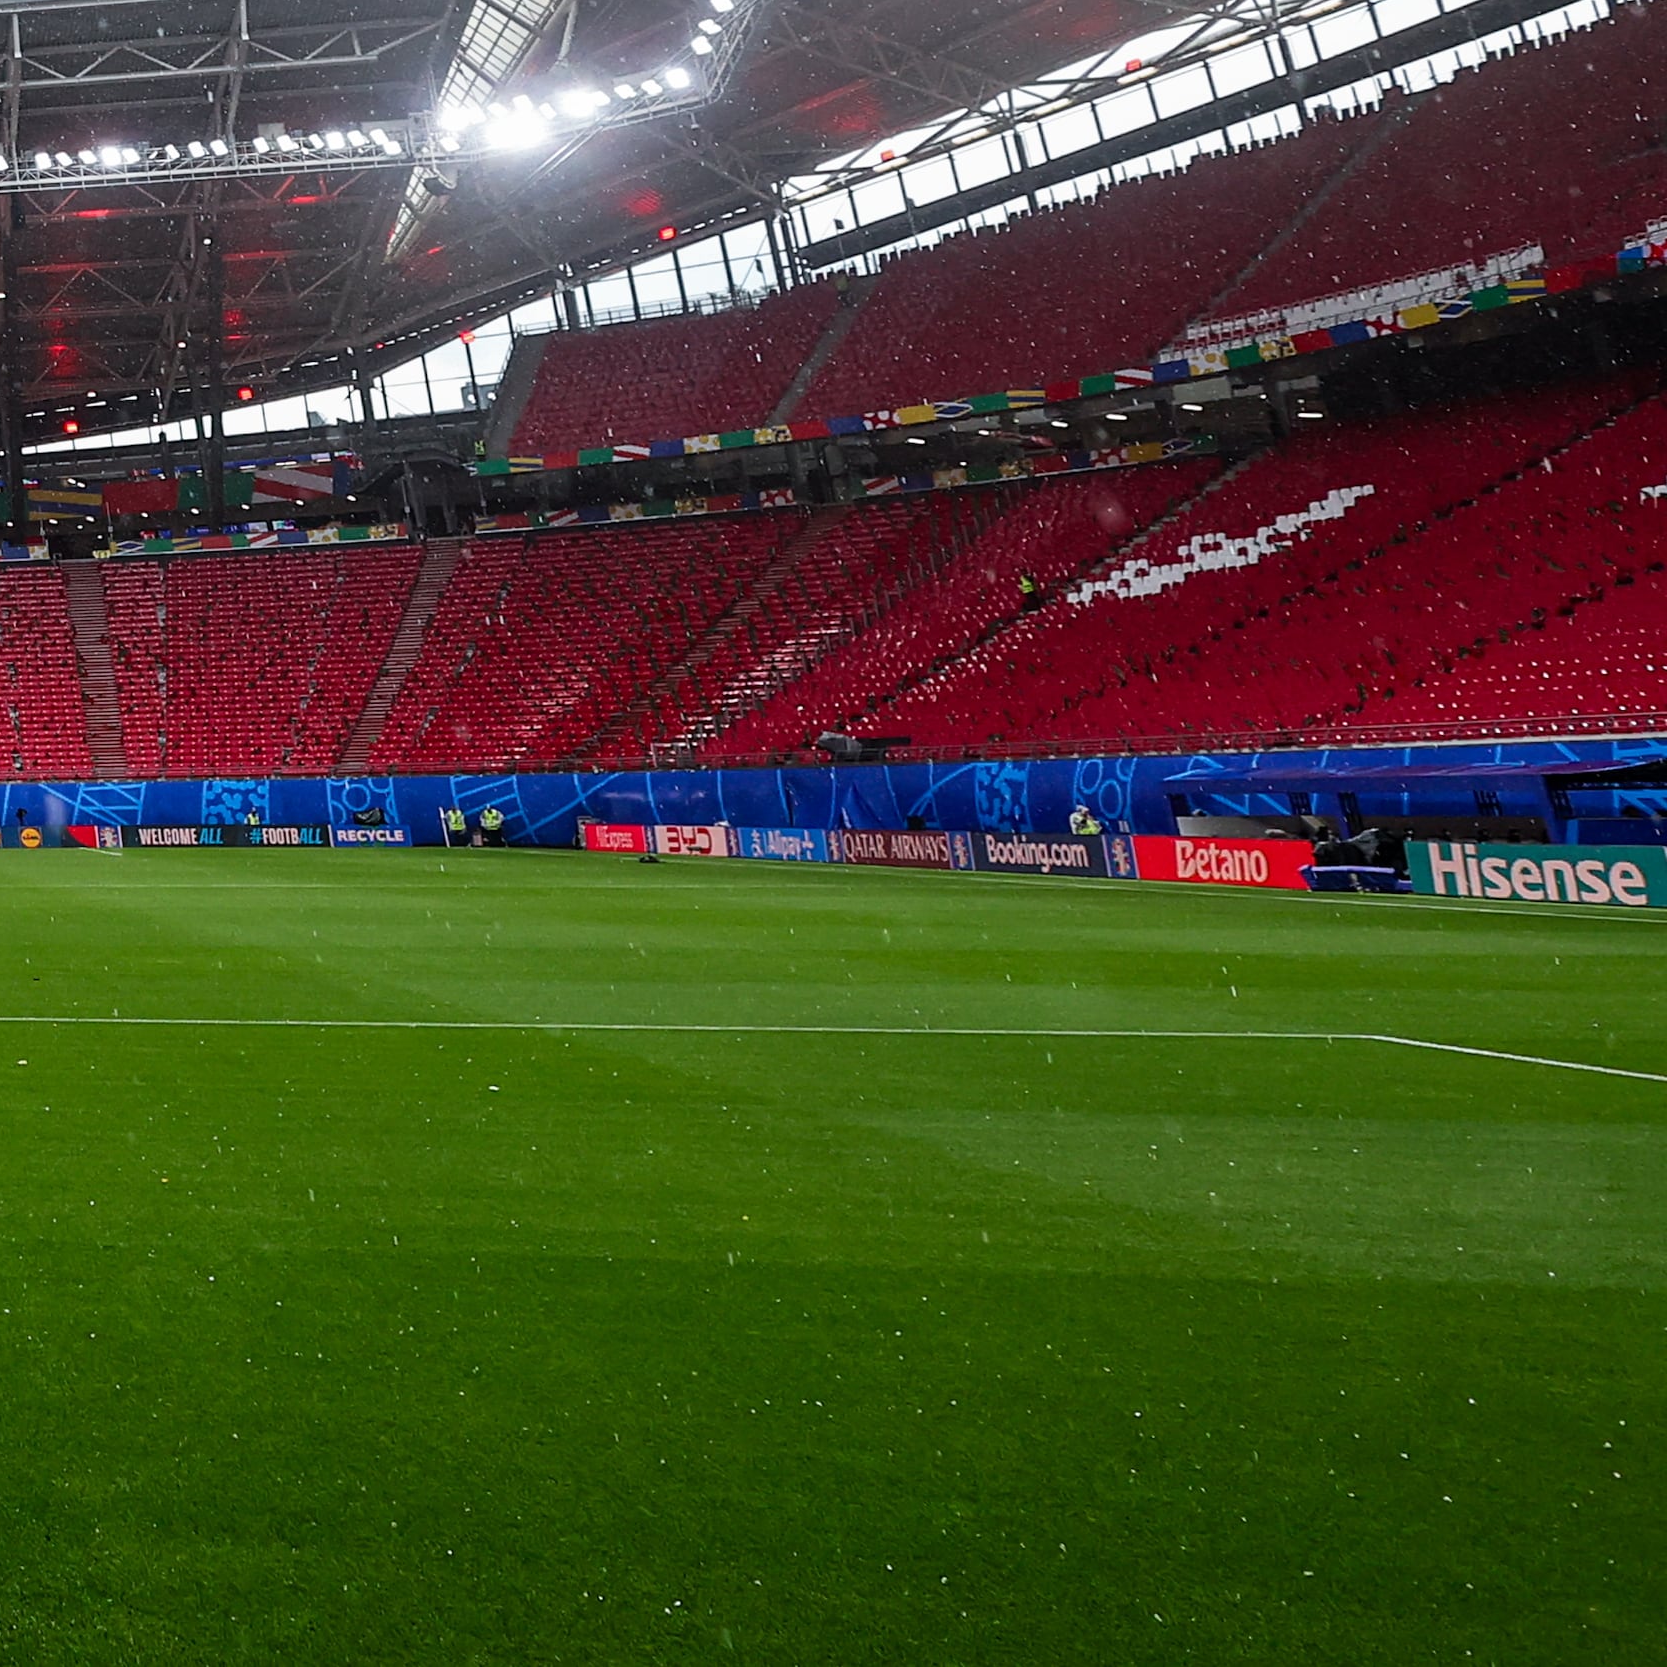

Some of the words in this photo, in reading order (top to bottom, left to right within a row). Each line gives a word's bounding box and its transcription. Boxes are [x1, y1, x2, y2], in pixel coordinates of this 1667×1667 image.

[138, 828, 198, 845] WELCOME
[199, 827, 224, 844] ALL
[249, 827, 323, 845] #FOOTBALL
[336, 829, 404, 842] RECYCLE
[844, 832, 887, 862] QATAR
[890, 834, 948, 862] AIRWAYS
[985, 834, 1089, 873] Booking.com
[1175, 839, 1268, 883] Betano
[1428, 842, 1648, 906] Hisense
